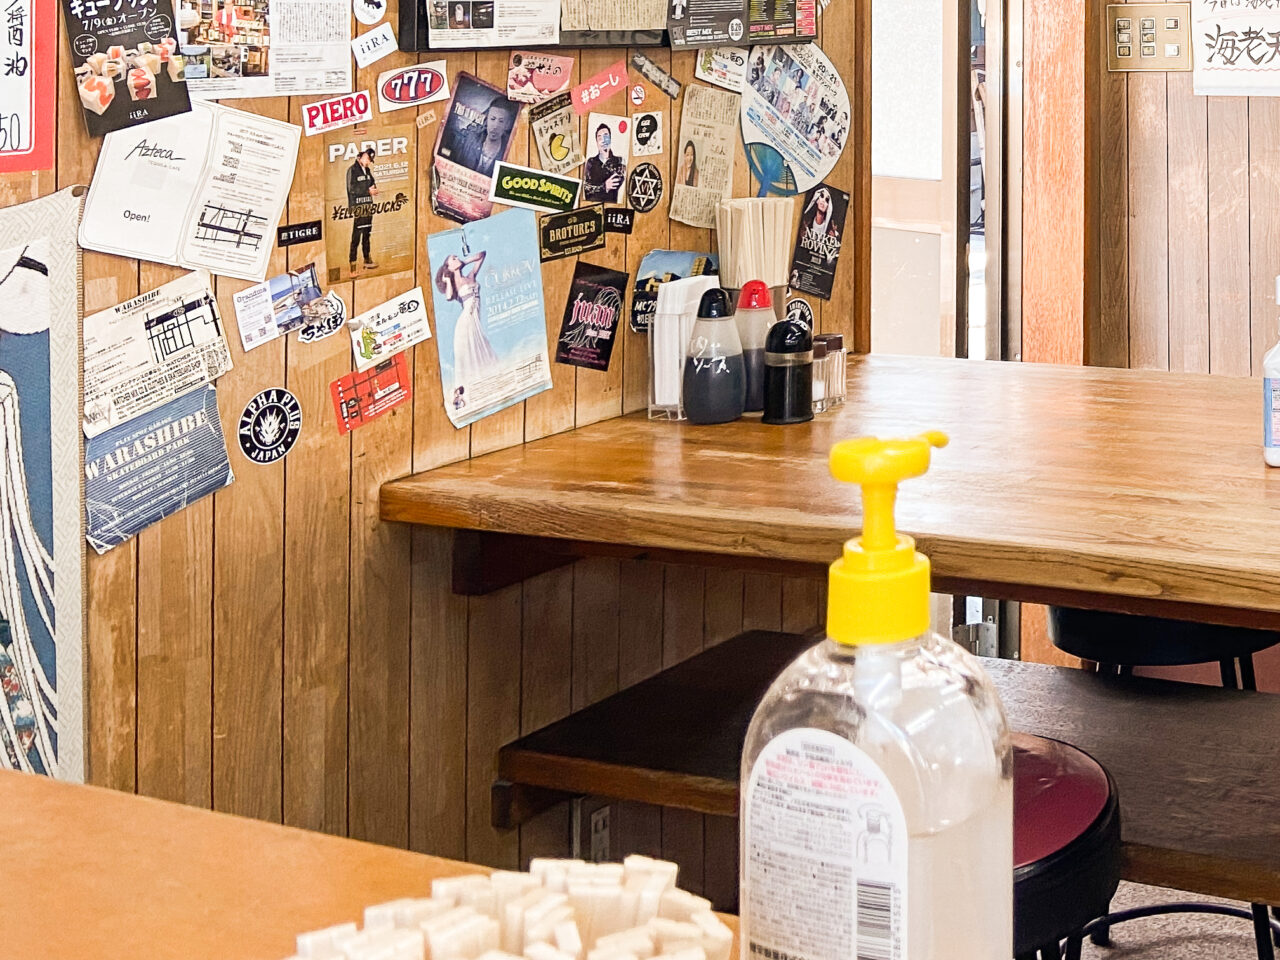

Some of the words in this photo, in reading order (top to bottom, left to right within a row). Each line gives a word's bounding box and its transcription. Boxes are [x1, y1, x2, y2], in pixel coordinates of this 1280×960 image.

[391, 71, 433, 100] 777
[307, 93, 369, 129] PIERO
[124, 138, 186, 161] Azteca
[501, 175, 539, 191] GOOD
[123, 208, 151, 223] Open!
[240, 390, 279, 436] ALPHA
[280, 393, 301, 430] PLUS
[251, 444, 286, 461] JAPAN
